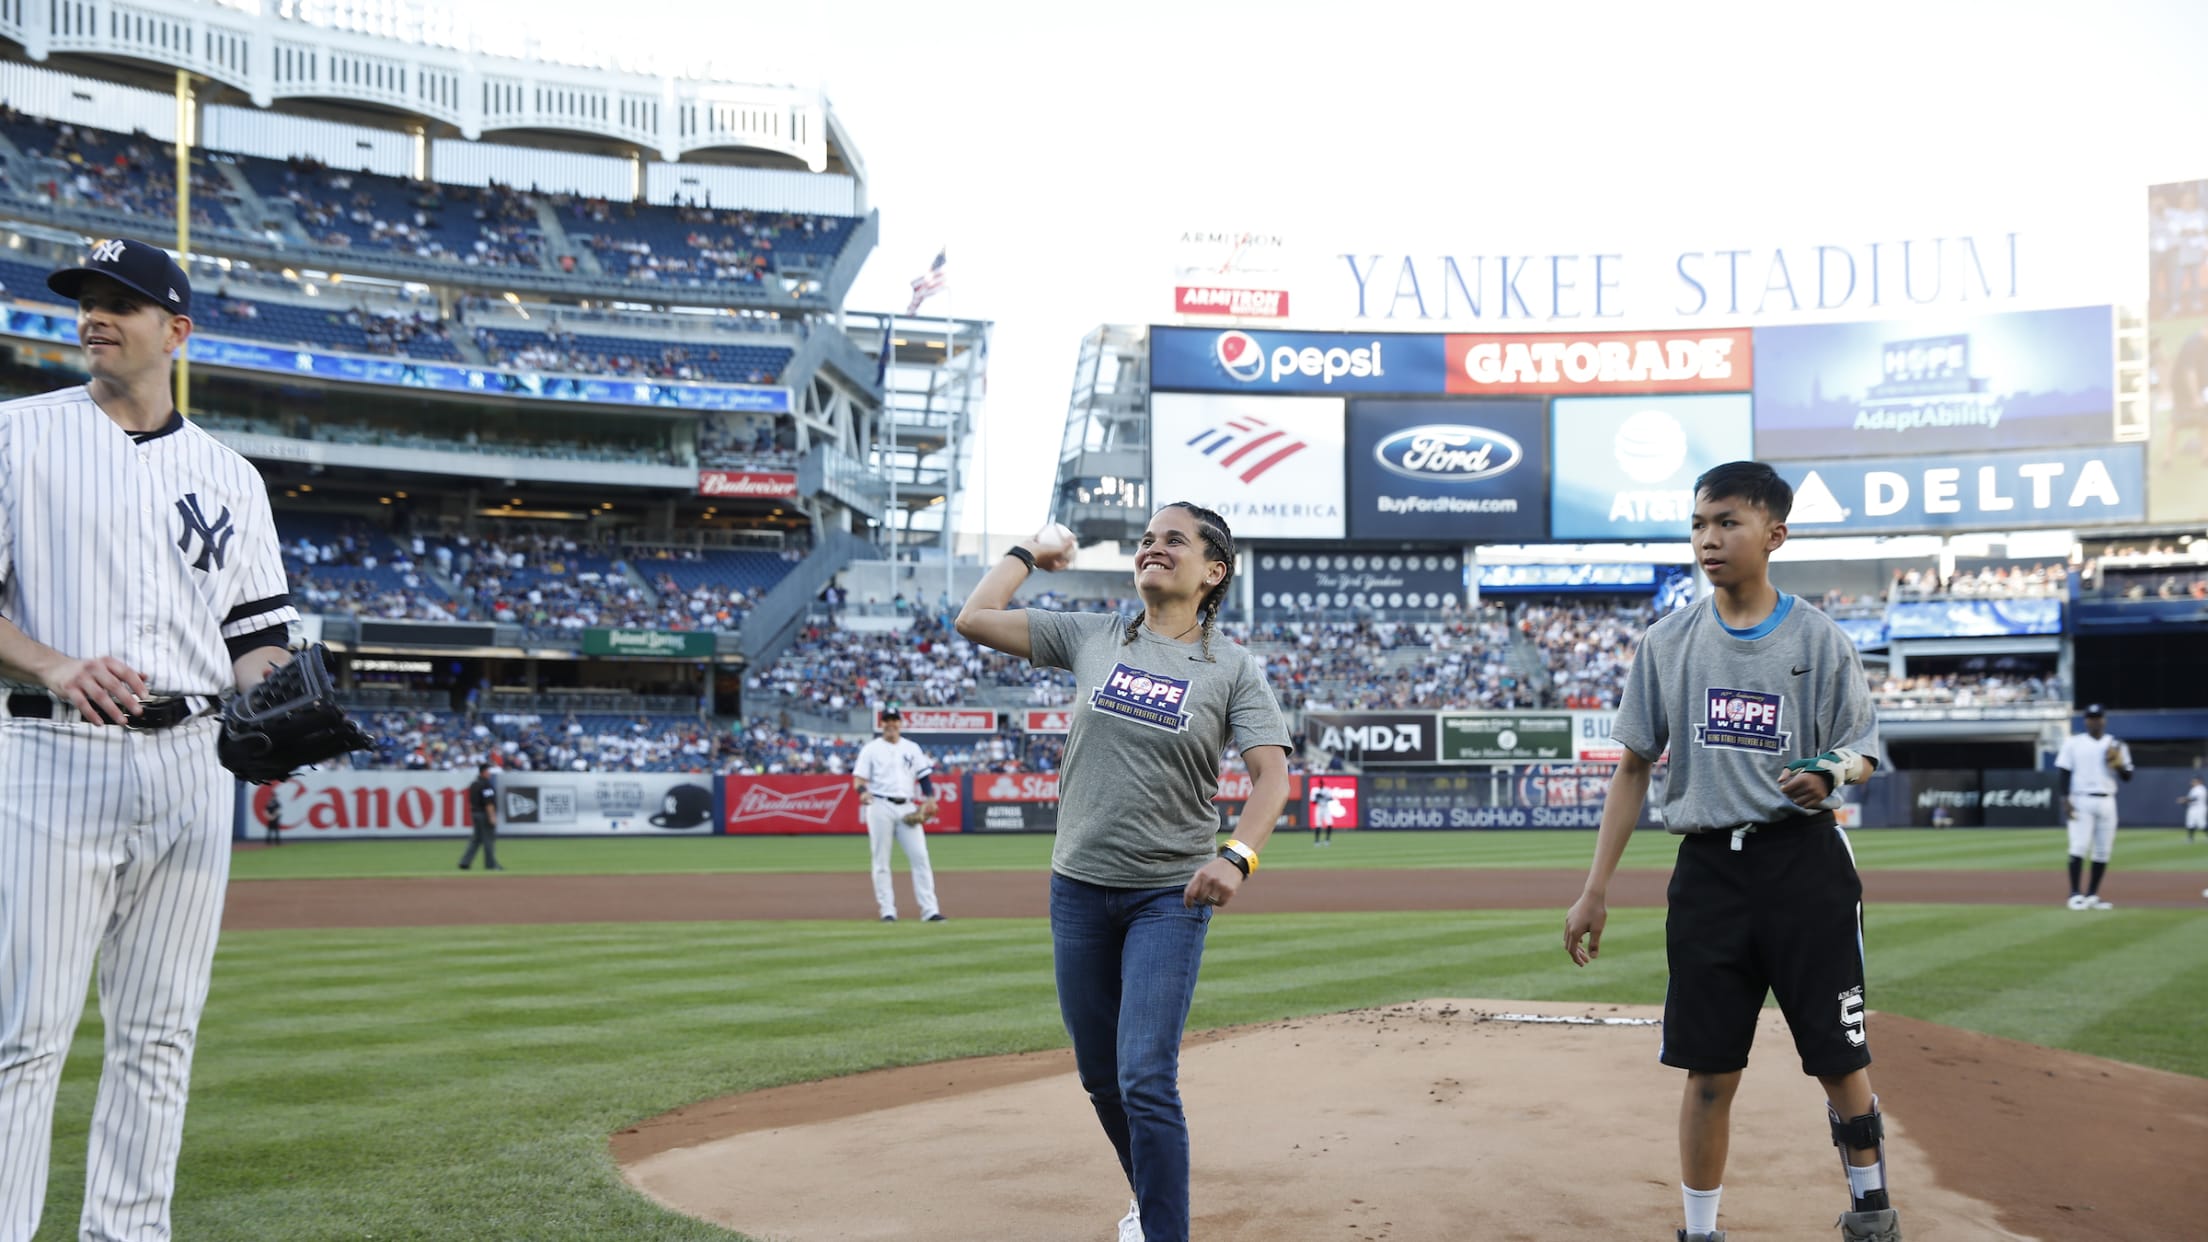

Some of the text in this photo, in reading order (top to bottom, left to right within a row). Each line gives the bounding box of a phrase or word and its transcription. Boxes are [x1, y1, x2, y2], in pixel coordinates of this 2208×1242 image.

[1337, 232, 2021, 319] YANKEE STADIUM
[1182, 288, 1280, 306] ARMITRON
[1271, 341, 1380, 384] pepsi
[1464, 338, 1734, 383] GATORADE
[1854, 401, 2003, 432] AdaptAbility
[1402, 433, 1494, 472] Ford
[703, 473, 796, 495] Budweiser
[1864, 460, 2121, 517] DELTA
[1220, 503, 1239, 516] OF
[1247, 504, 1338, 518] AMERICA
[1377, 496, 1518, 514] BuyFordNow.com
[1608, 489, 1693, 522] AT&T
[1110, 671, 1184, 704] HOPE
[1116, 689, 1167, 708] WEEK
[1711, 699, 1777, 725] HOPE
[1717, 720, 1766, 732] WEEK
[1320, 726, 1395, 751] AMD
[253, 778, 474, 830] Canon
[743, 793, 838, 812] Budweiser
[1369, 808, 1444, 828] StubHub
[1450, 808, 1526, 828] StubHub
[1840, 994, 1865, 1048] 5
